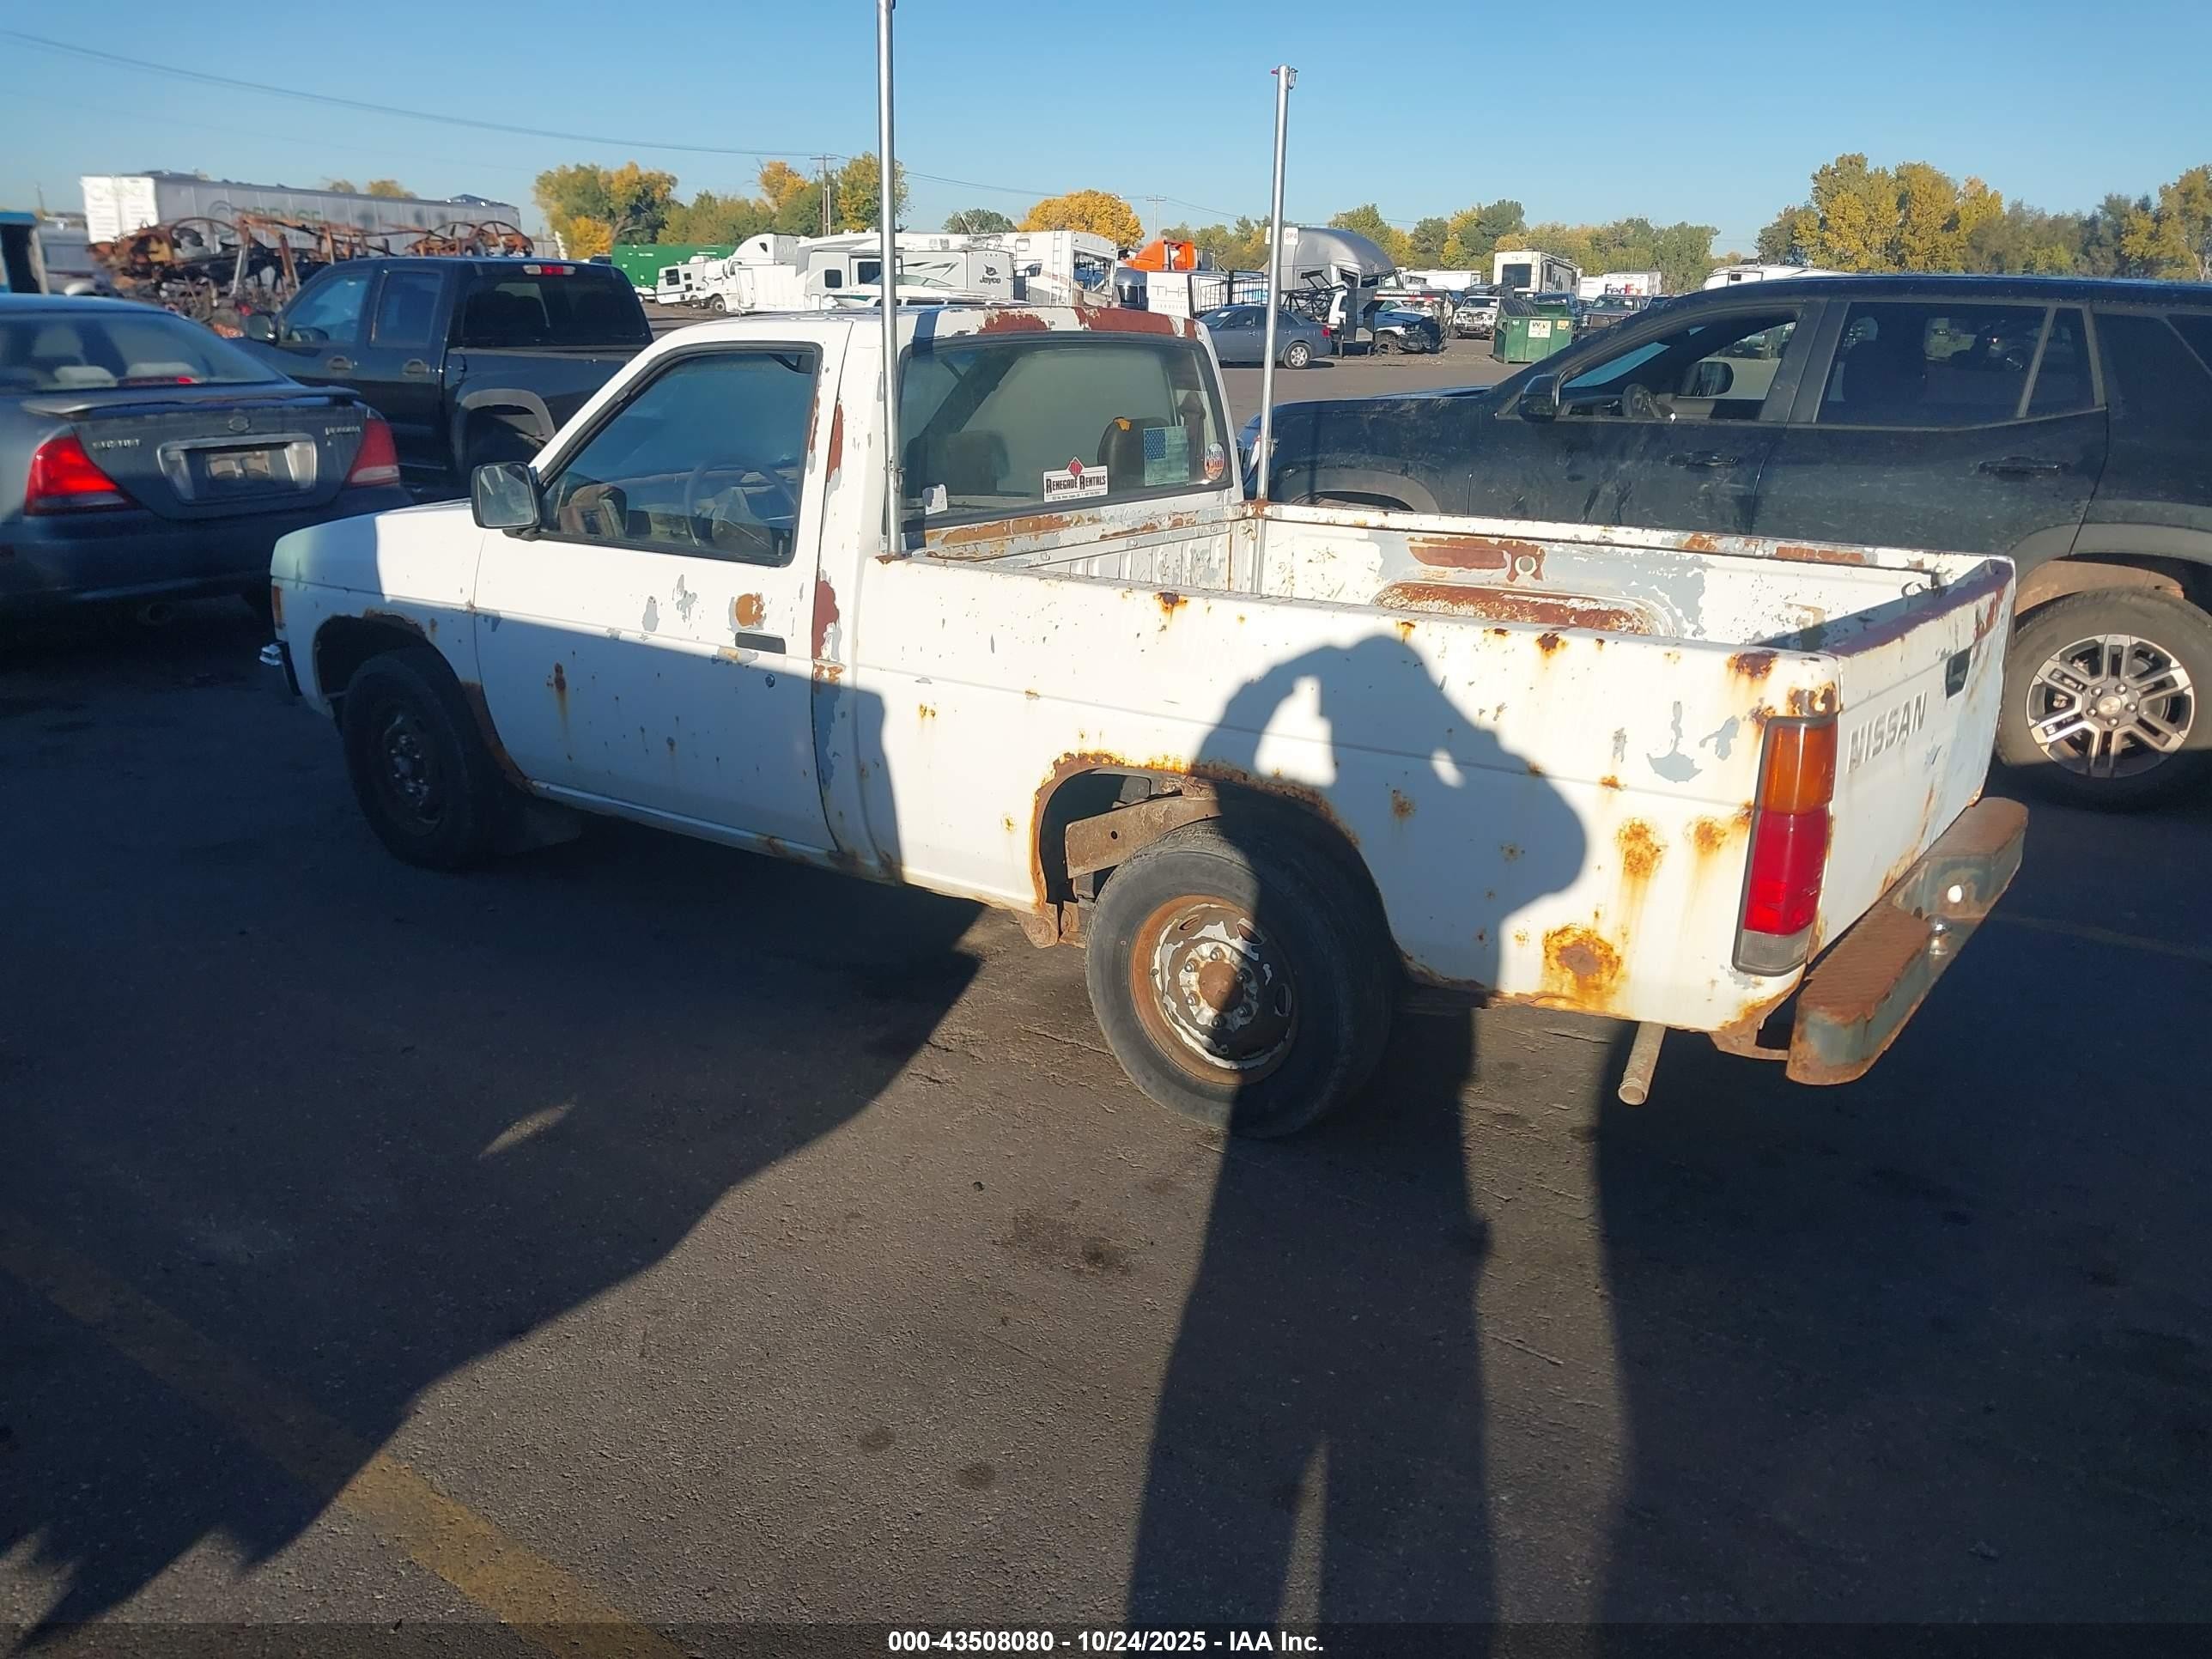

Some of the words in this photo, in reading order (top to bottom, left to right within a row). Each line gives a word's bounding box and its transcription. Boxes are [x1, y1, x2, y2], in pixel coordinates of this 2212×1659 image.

[980, 275, 1001, 285] Jayco
[1605, 283, 1644, 295] FedEx
[1046, 477, 1078, 494] RENEGADE
[1079, 475, 1106, 489] RENTALS
[1846, 690, 1927, 774] NISSAN
